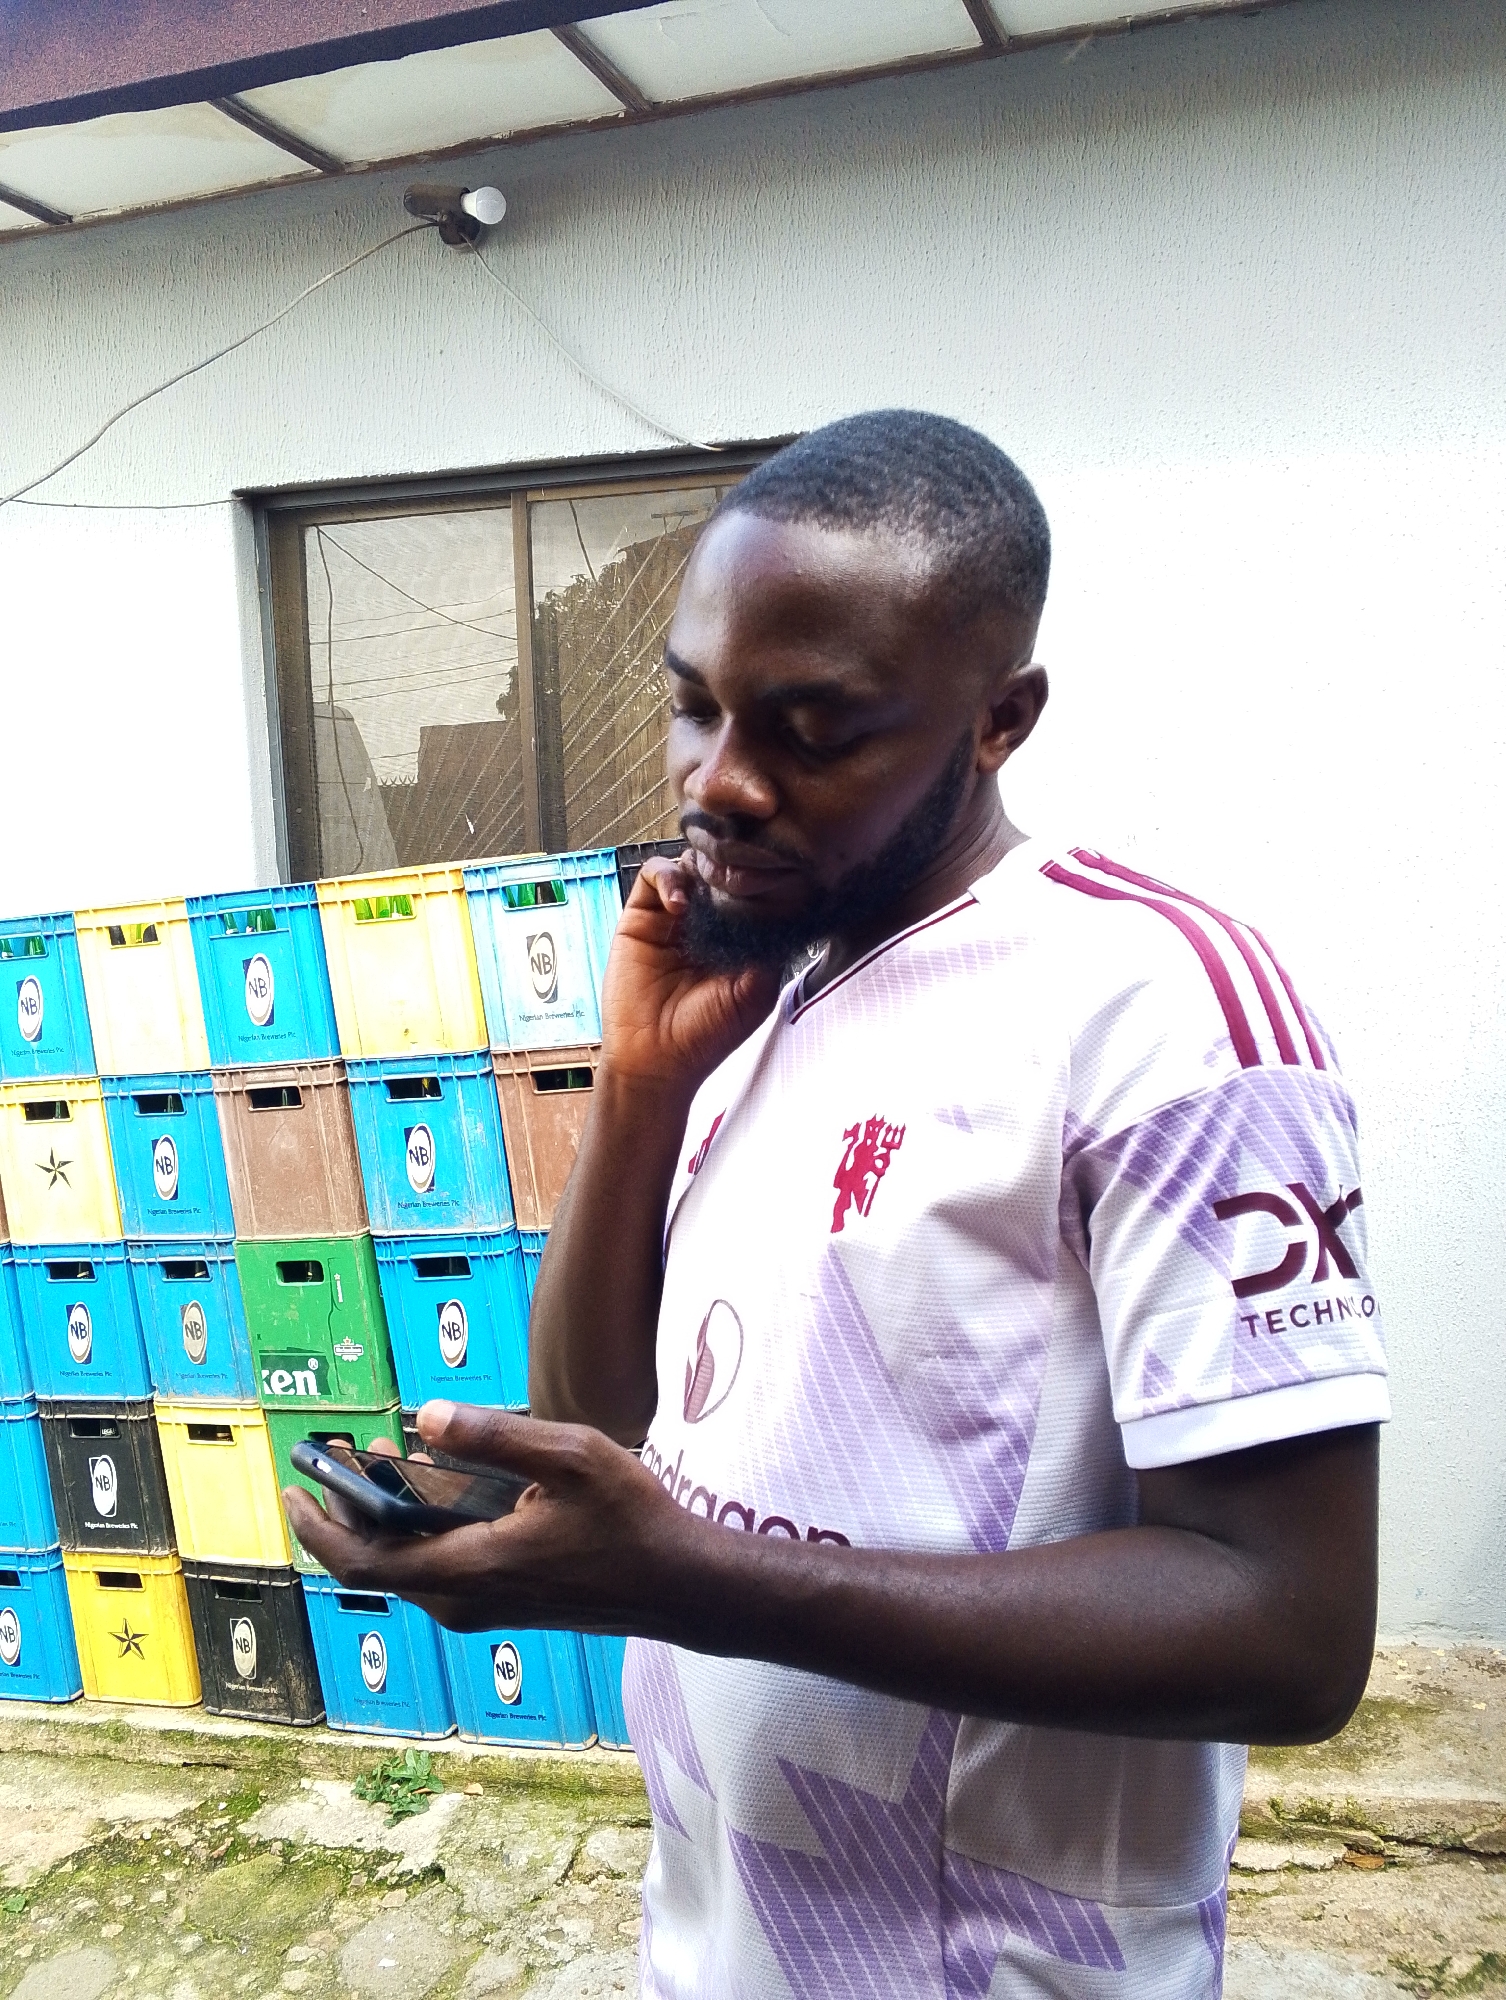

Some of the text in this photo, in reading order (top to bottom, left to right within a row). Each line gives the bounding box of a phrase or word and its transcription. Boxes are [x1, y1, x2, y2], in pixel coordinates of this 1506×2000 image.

[531, 953, 553, 976] NB
[249, 977, 268, 1000] NB
[21, 996, 38, 1016] NB
[156, 1155, 173, 1175] NB
[409, 1146, 428, 1167] NB
[1241, 1294, 1382, 1338] TECHNO
[70, 1320, 87, 1340] NB
[185, 1321, 202, 1341] NB
[441, 1321, 462, 1342] NB
[96, 1473, 110, 1492] NB
[235, 1638, 250, 1655] NB
[362, 1650, 381, 1670] NB
[496, 1660, 516, 1682] NB
